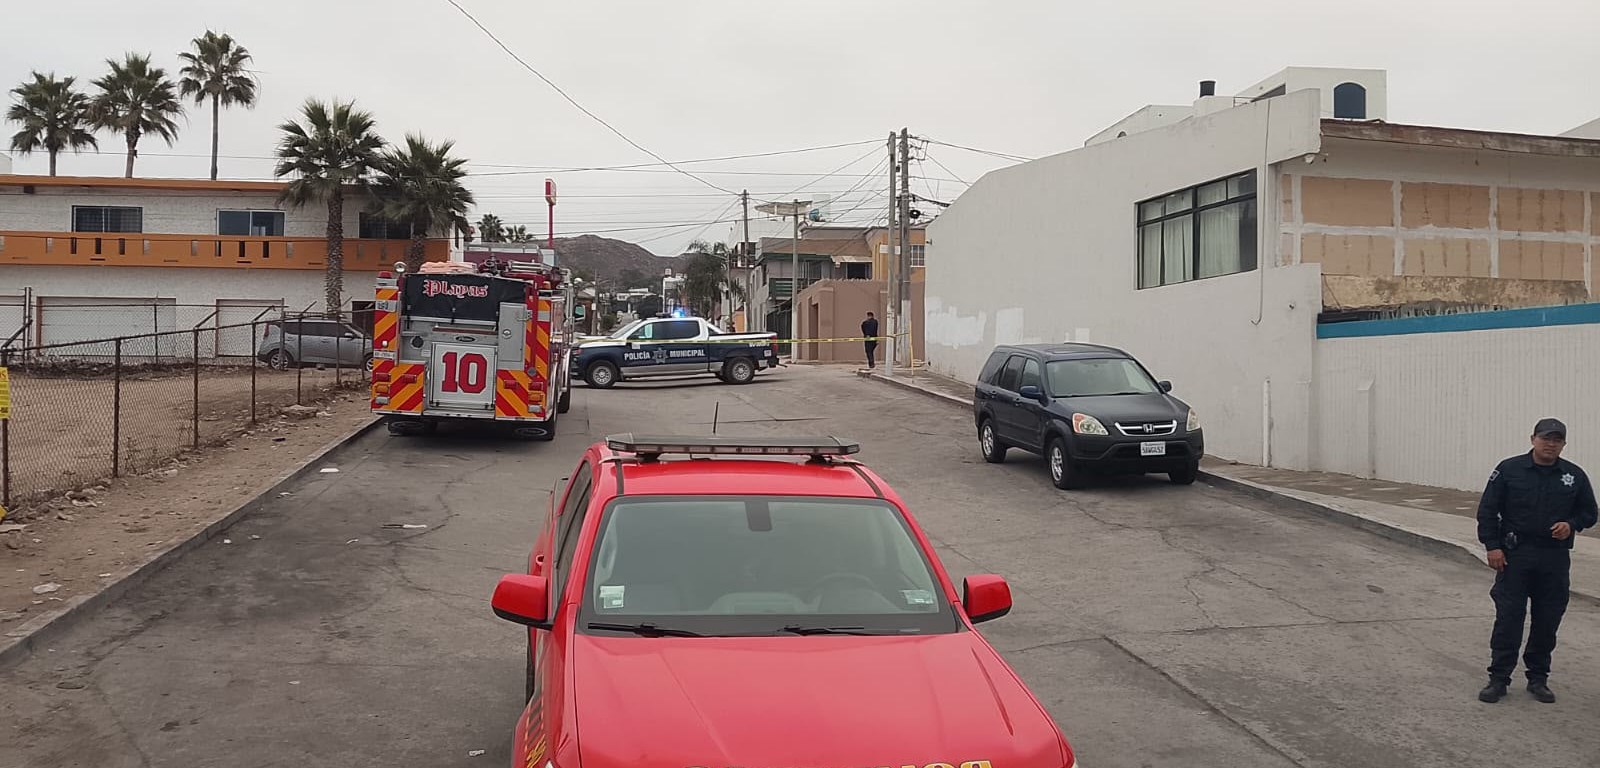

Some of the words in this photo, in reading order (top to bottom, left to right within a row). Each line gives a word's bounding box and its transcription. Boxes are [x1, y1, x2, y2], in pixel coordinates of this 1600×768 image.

[422, 279, 487, 298] Playas
[624, 351, 651, 361] POLICÍA
[670, 349, 705, 357] MUNICIPAL
[442, 352, 487, 394] 10
